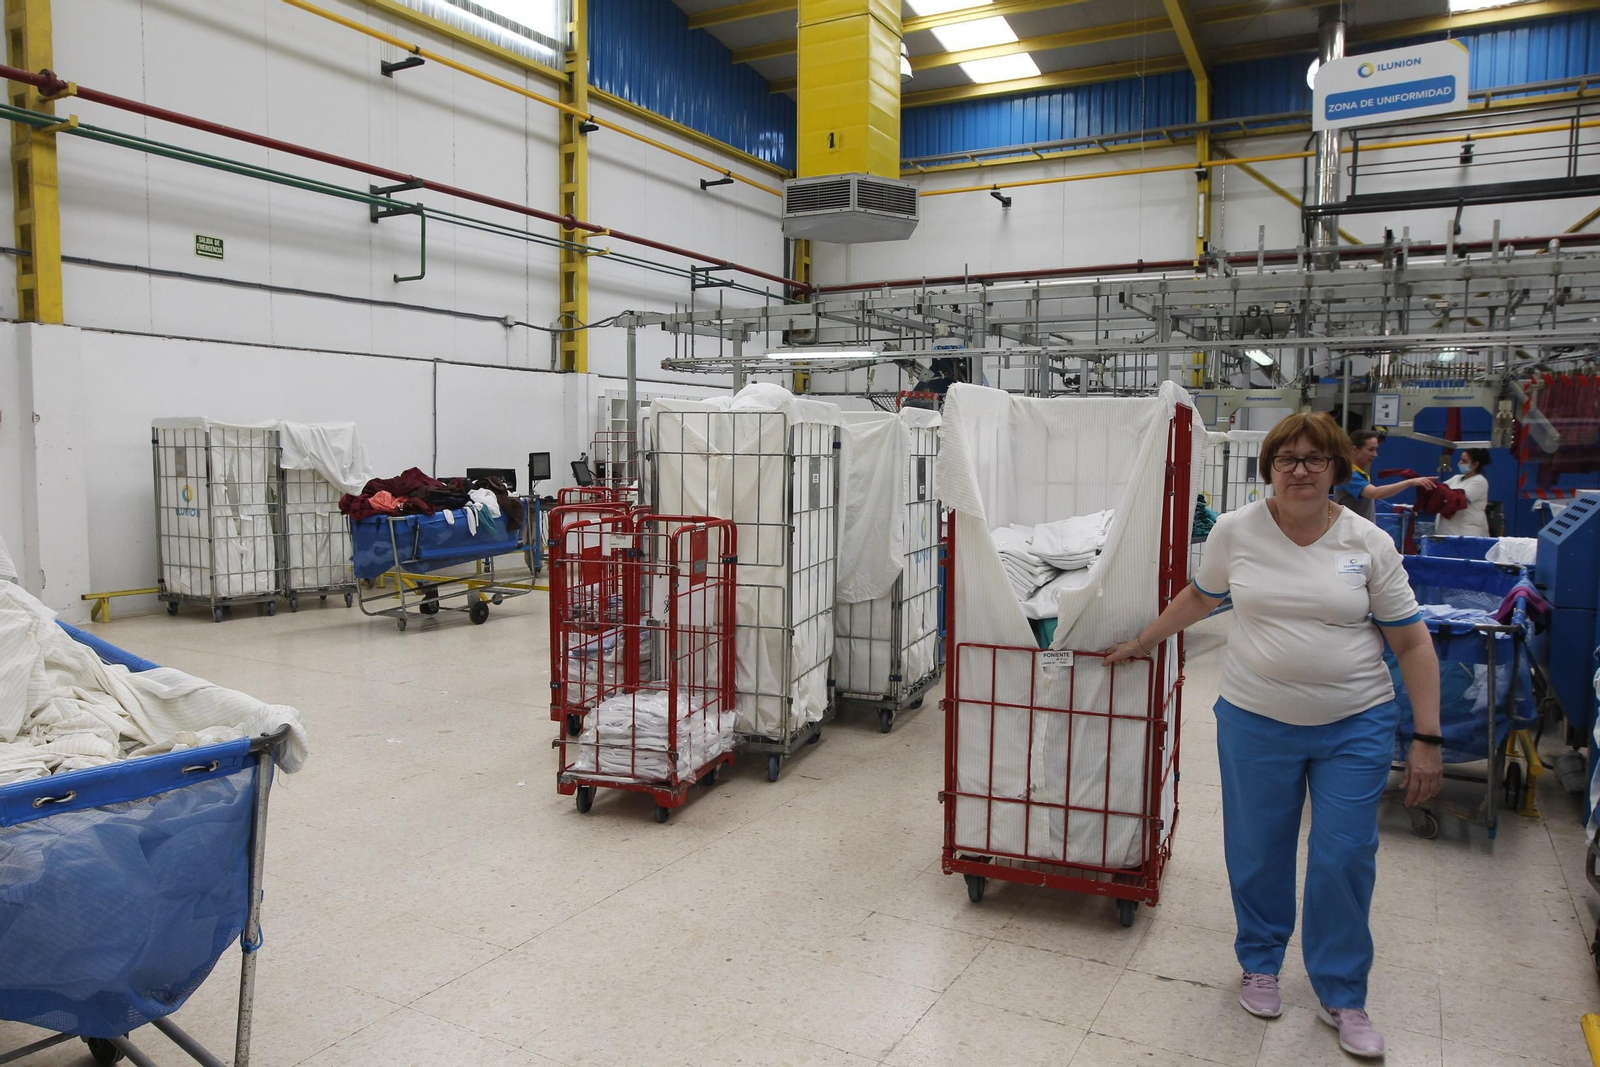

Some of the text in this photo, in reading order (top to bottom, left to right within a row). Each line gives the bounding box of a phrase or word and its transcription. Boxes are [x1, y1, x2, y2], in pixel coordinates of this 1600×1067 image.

[1377, 57, 1422, 72] ILUNION
[1328, 86, 1452, 113] ZONA DE UNIFORMIDAD
[198, 236, 221, 247] SALIDA DE
[197, 243, 222, 254] EMERGENCIA
